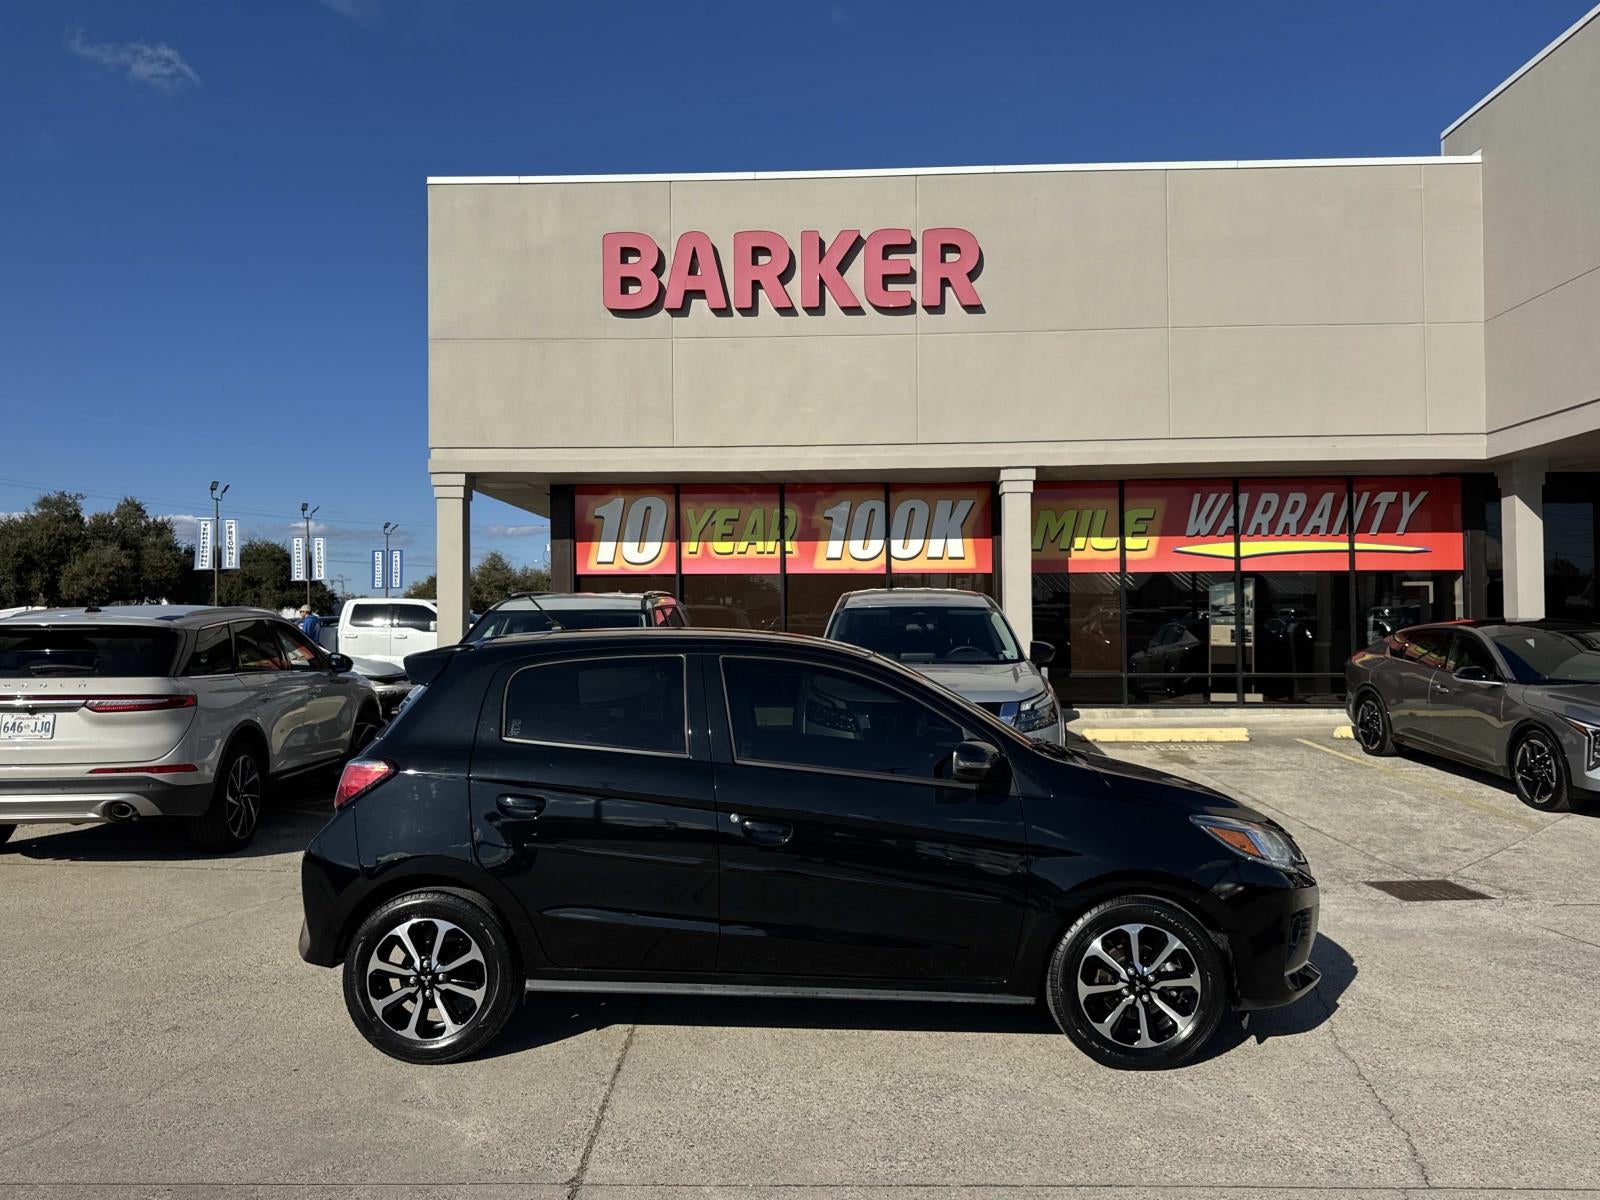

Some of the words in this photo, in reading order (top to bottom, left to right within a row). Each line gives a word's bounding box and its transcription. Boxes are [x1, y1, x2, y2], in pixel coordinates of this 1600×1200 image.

[602, 227, 986, 317] BARKER
[593, 496, 668, 565] 10
[686, 506, 798, 556] YEAR
[823, 499, 976, 562] 100K
[1031, 508, 1156, 552] MILE
[1184, 490, 1430, 537] WARRANTY
[3, 721, 24, 733] 646
